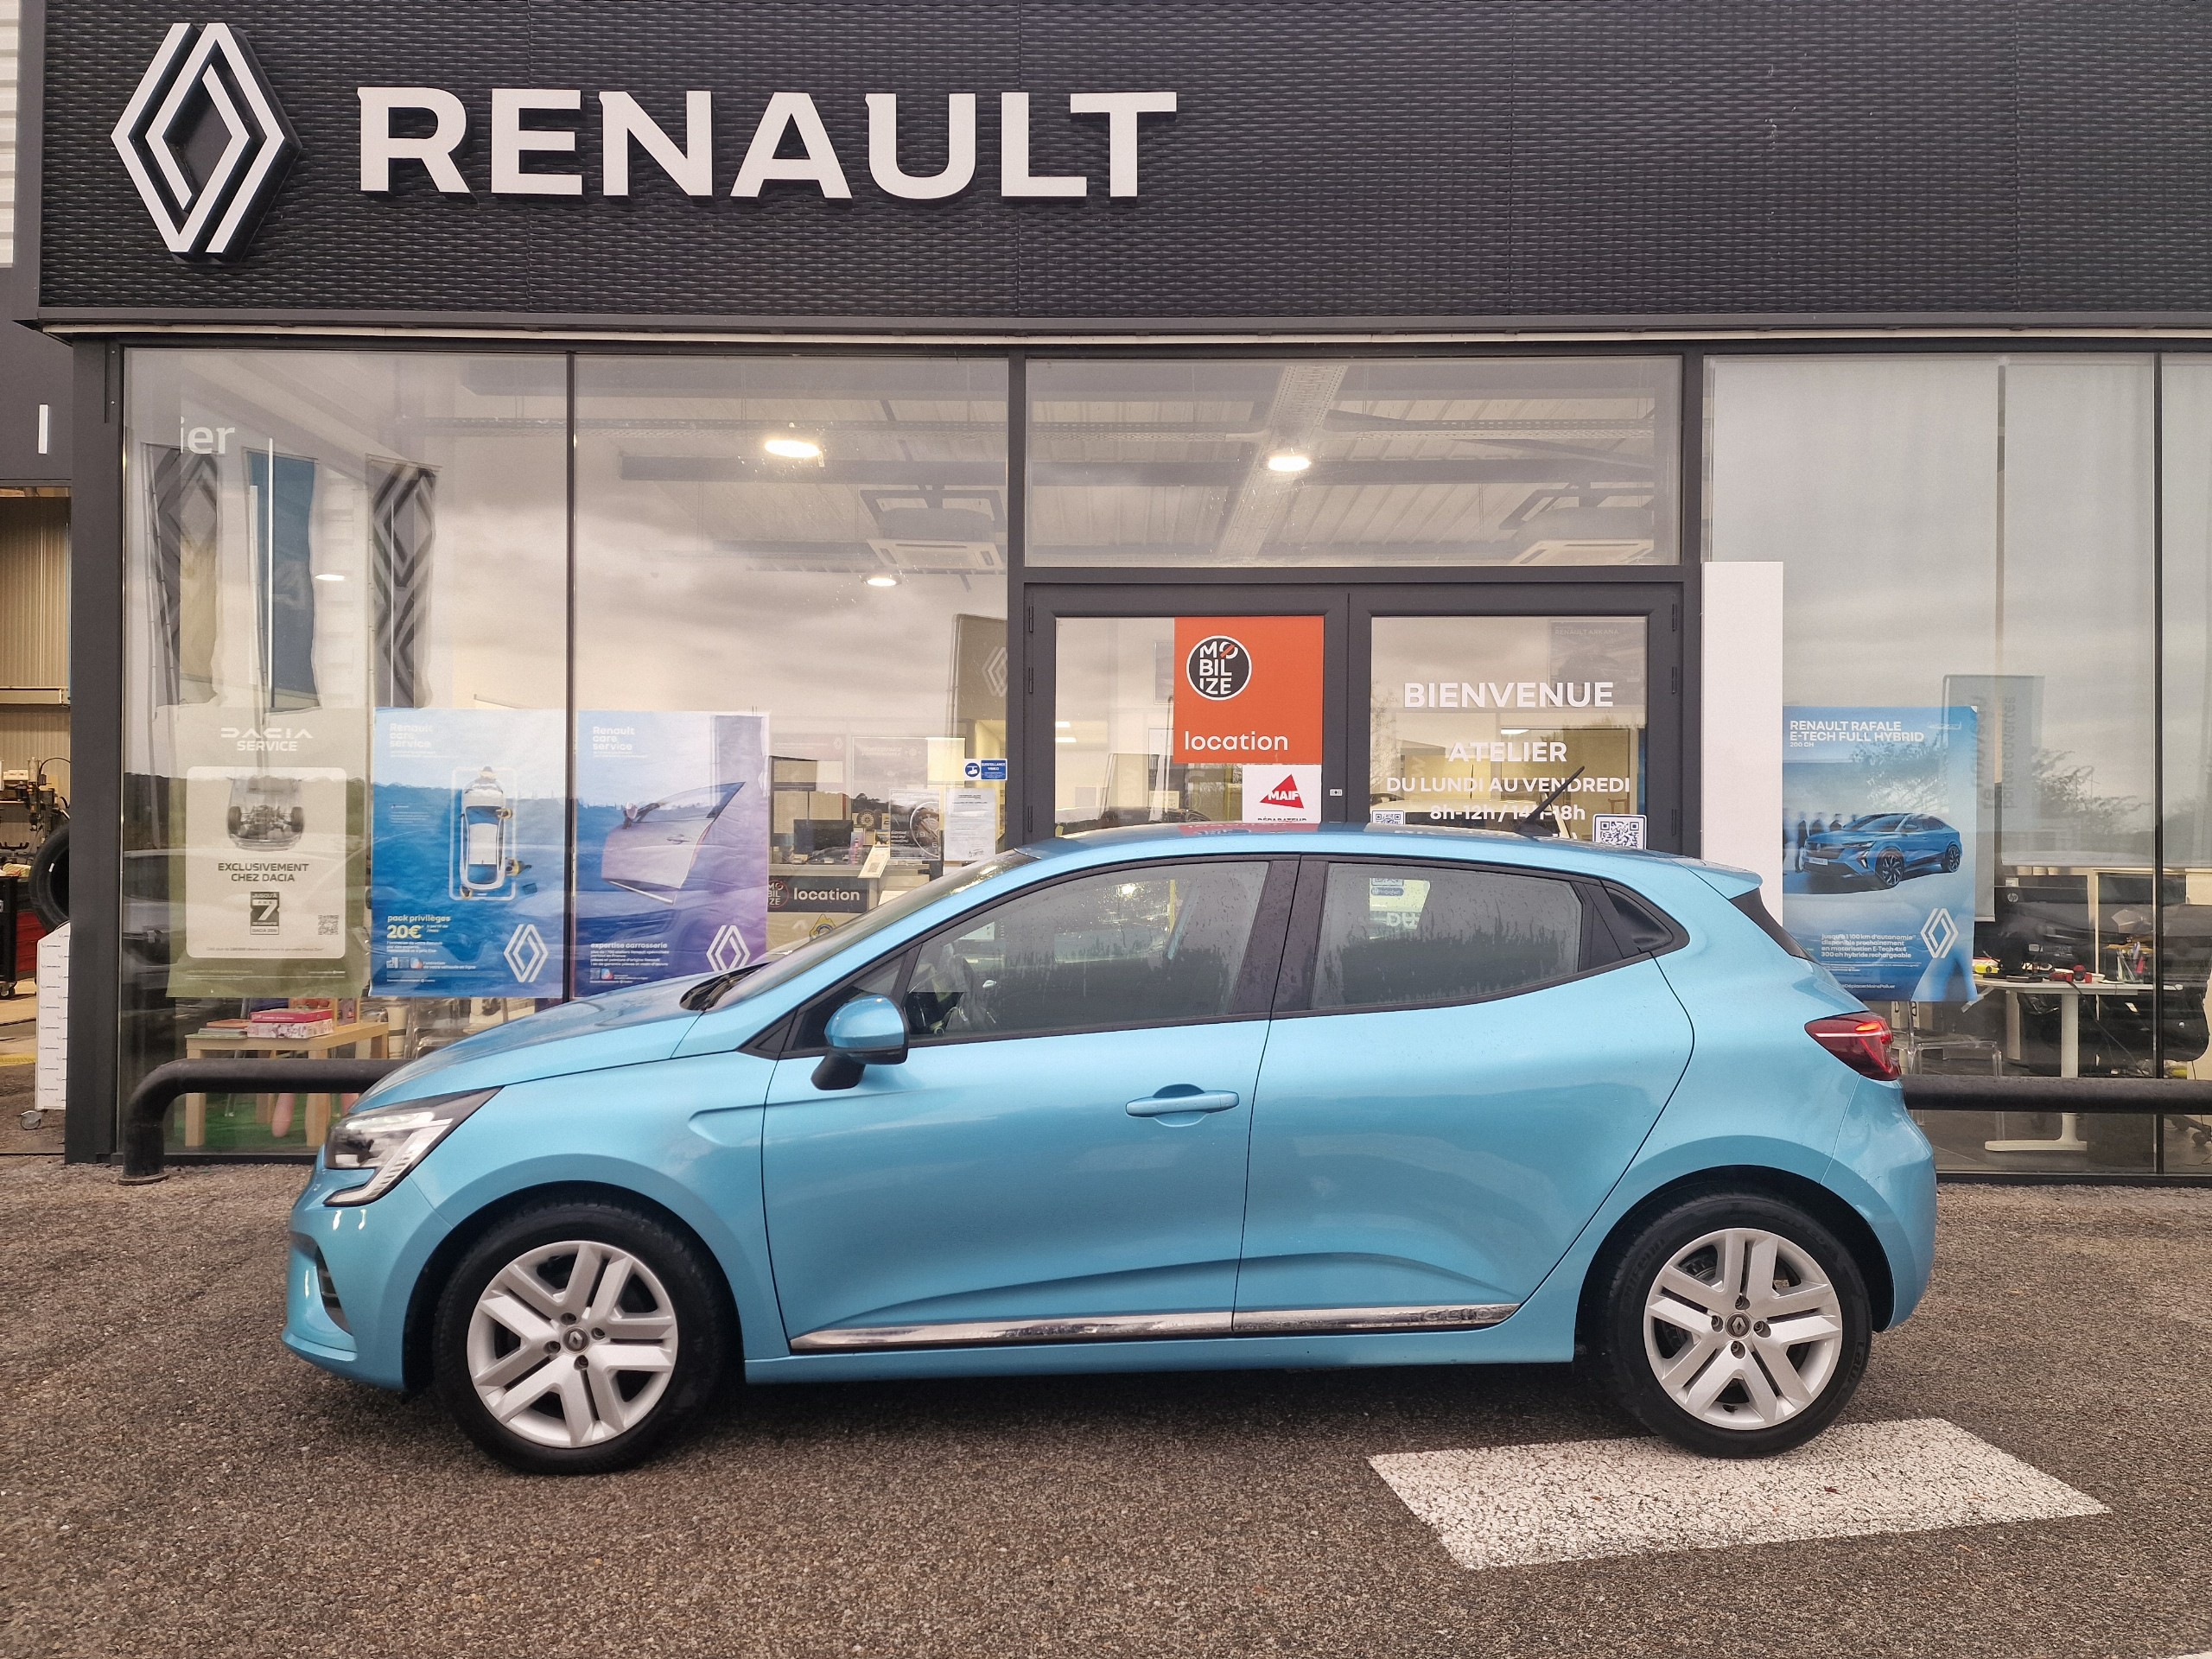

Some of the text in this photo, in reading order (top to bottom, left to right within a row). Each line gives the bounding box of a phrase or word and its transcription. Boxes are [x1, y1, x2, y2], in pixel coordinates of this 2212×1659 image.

[356, 86, 1177, 200] RENAULT
[1404, 683, 1614, 708] BIENVENUE
[593, 726, 635, 734] Renault
[1789, 721, 1901, 731] RENAULT RAFALE
[1185, 730, 1288, 751] location
[1789, 732, 1924, 742] E-TECH FULL HYBRID
[237, 740, 297, 751] SERVICE
[593, 742, 632, 751] service
[1448, 742, 1567, 762] ATELIER
[1387, 777, 1630, 792] DU LUNDI AU VENDREDI
[1268, 790, 1299, 801] MAIF
[1430, 804, 1495, 821] 8h-12h
[1497, 804, 1508, 823] /
[218, 862, 309, 872] EXCLUSIVEMENT
[231, 873, 295, 882] CHEZ DACIA
[793, 887, 861, 901] location
[387, 914, 409, 923] pack
